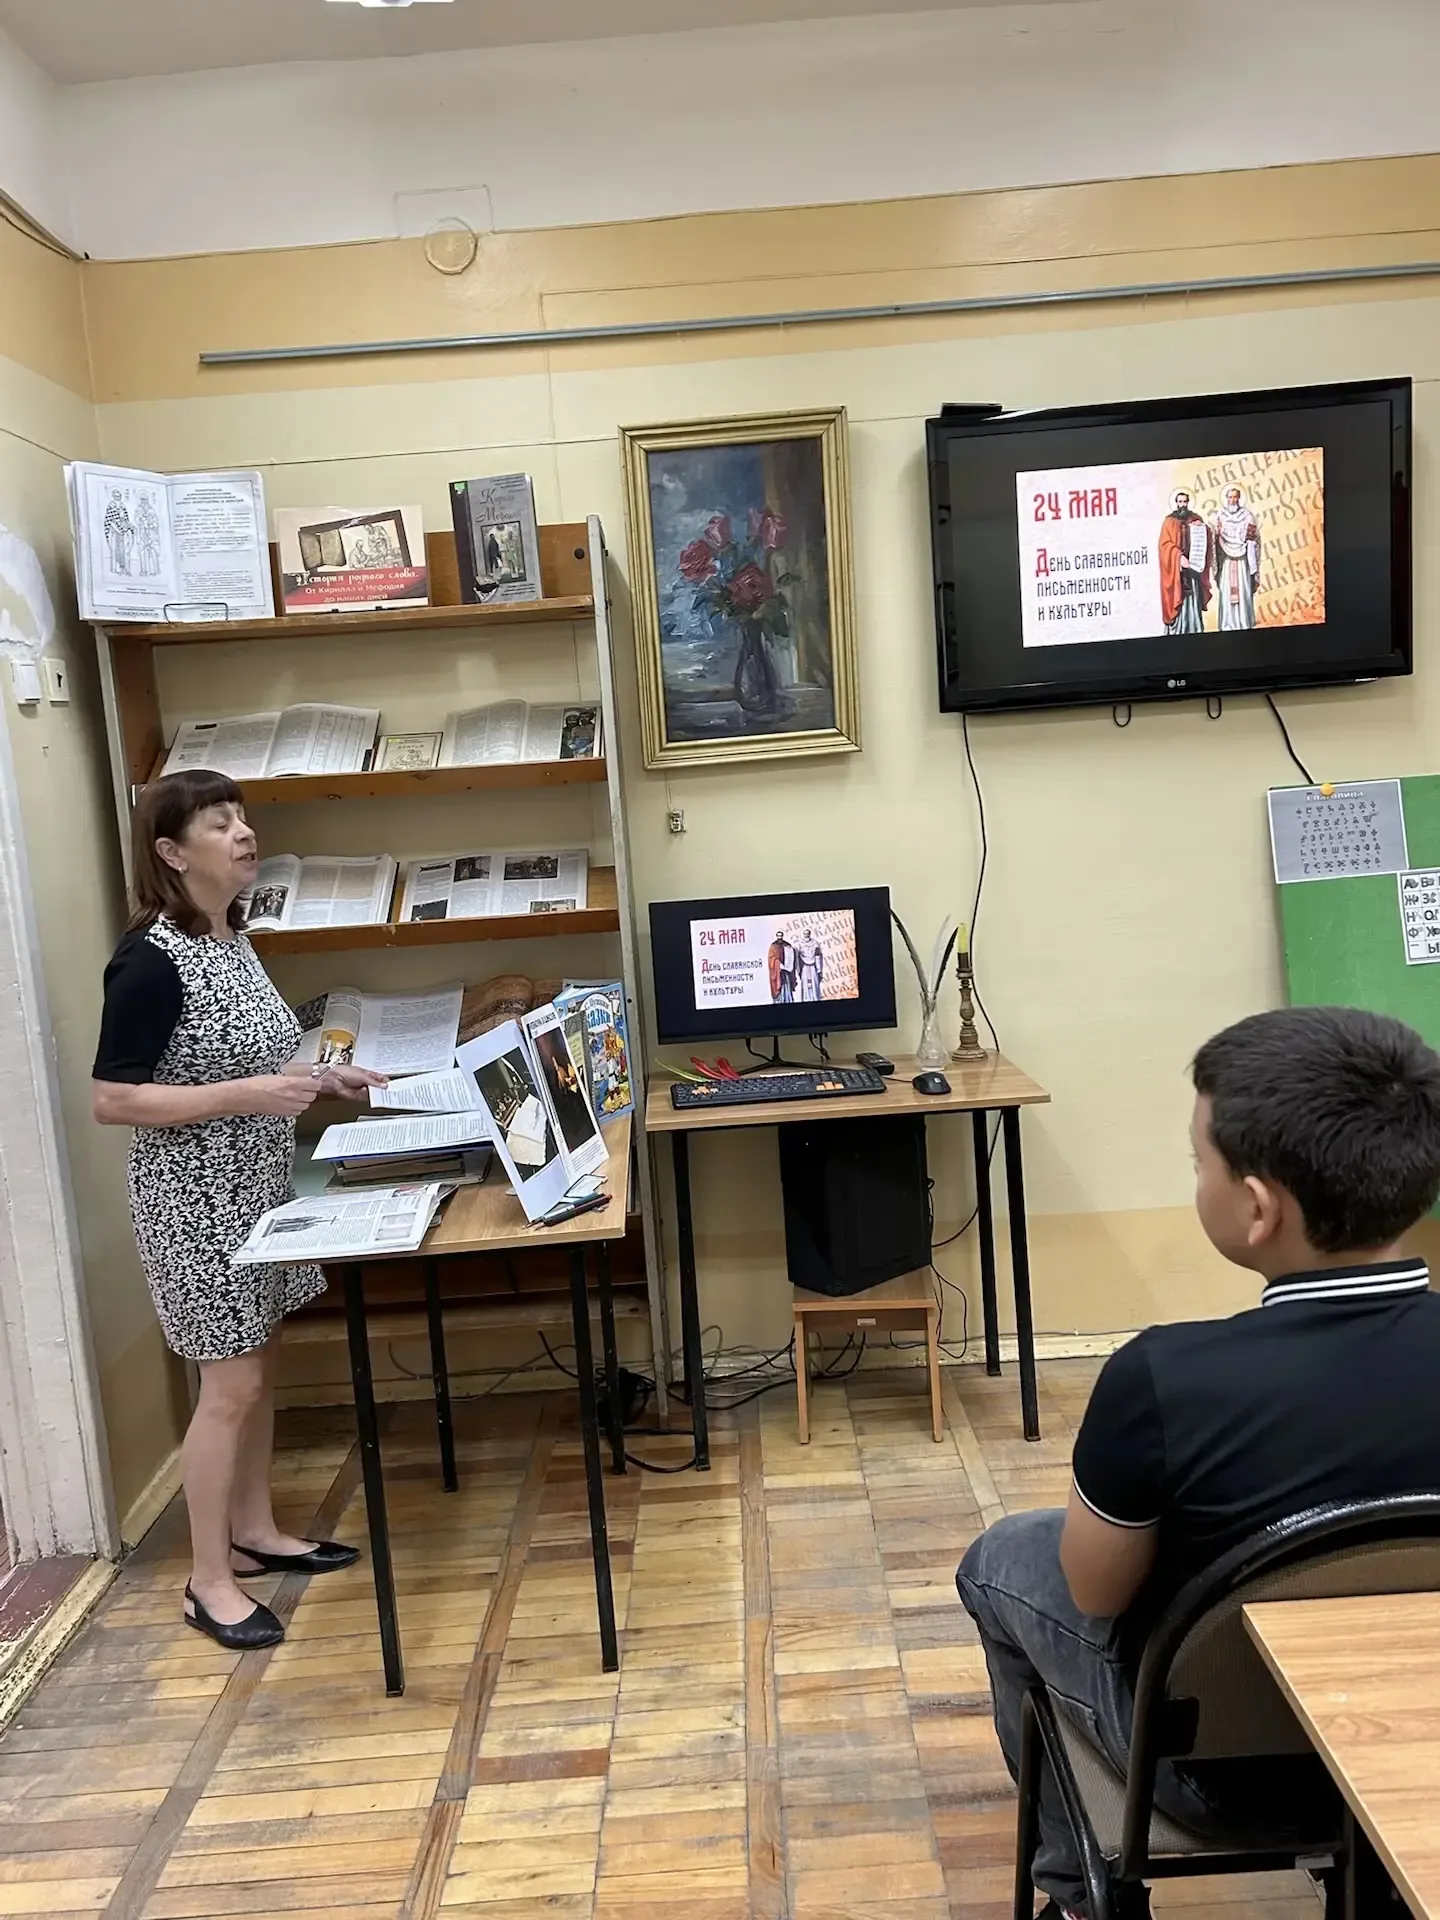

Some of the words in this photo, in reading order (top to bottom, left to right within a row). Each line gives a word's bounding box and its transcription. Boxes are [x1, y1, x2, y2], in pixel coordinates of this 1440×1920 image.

[1033, 492, 1062, 522] 24
[1069, 487, 1118, 519] МАЯ
[305, 587, 316, 595] От
[1306, 791, 1364, 801] Глаолица
[700, 931, 716, 946] 24
[718, 929, 745, 944] МАЯ
